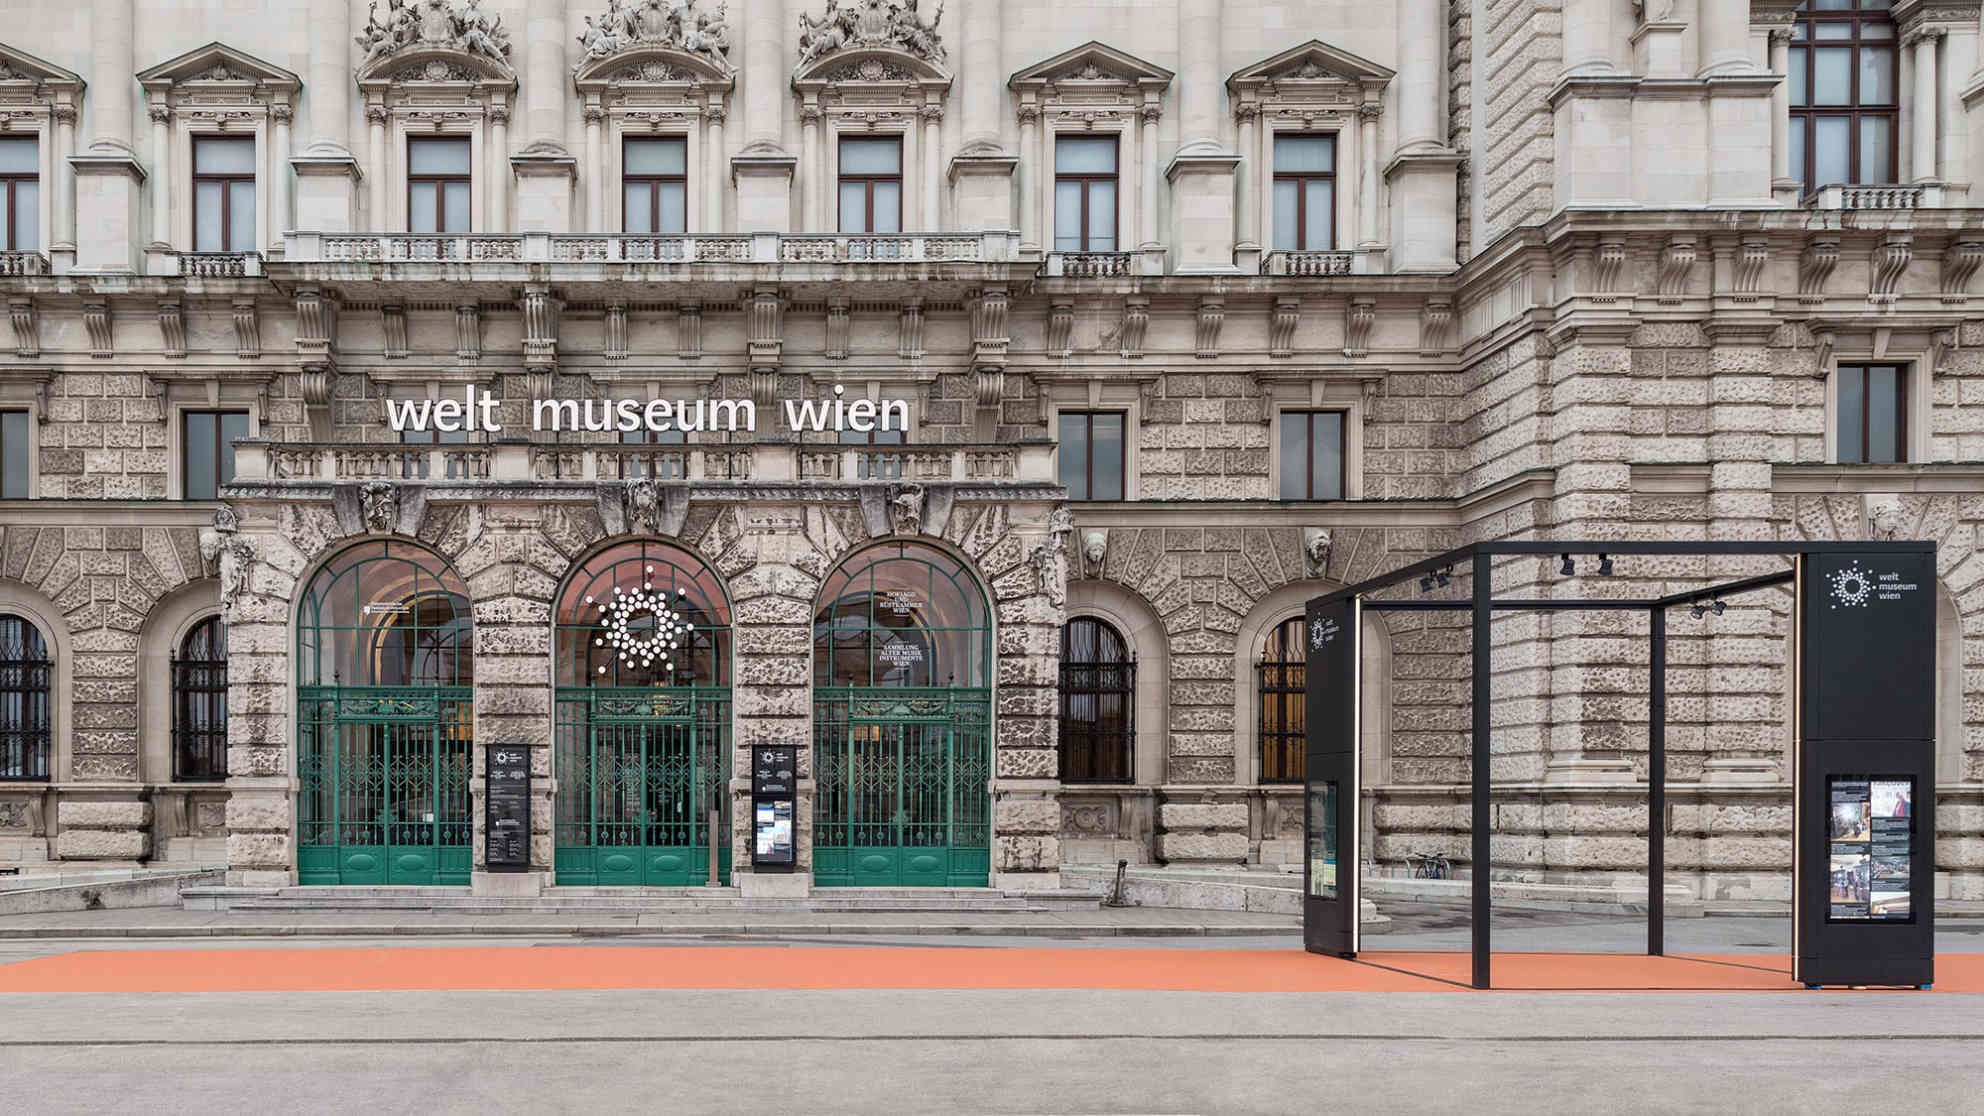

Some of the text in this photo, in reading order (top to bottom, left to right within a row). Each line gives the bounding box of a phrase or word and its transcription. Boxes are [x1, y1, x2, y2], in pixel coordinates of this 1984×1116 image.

[385, 384, 909, 432] welt museum wien
[1879, 572, 1899, 581] welt
[1879, 583, 1917, 591] museum
[1879, 591, 1901, 600] wien
